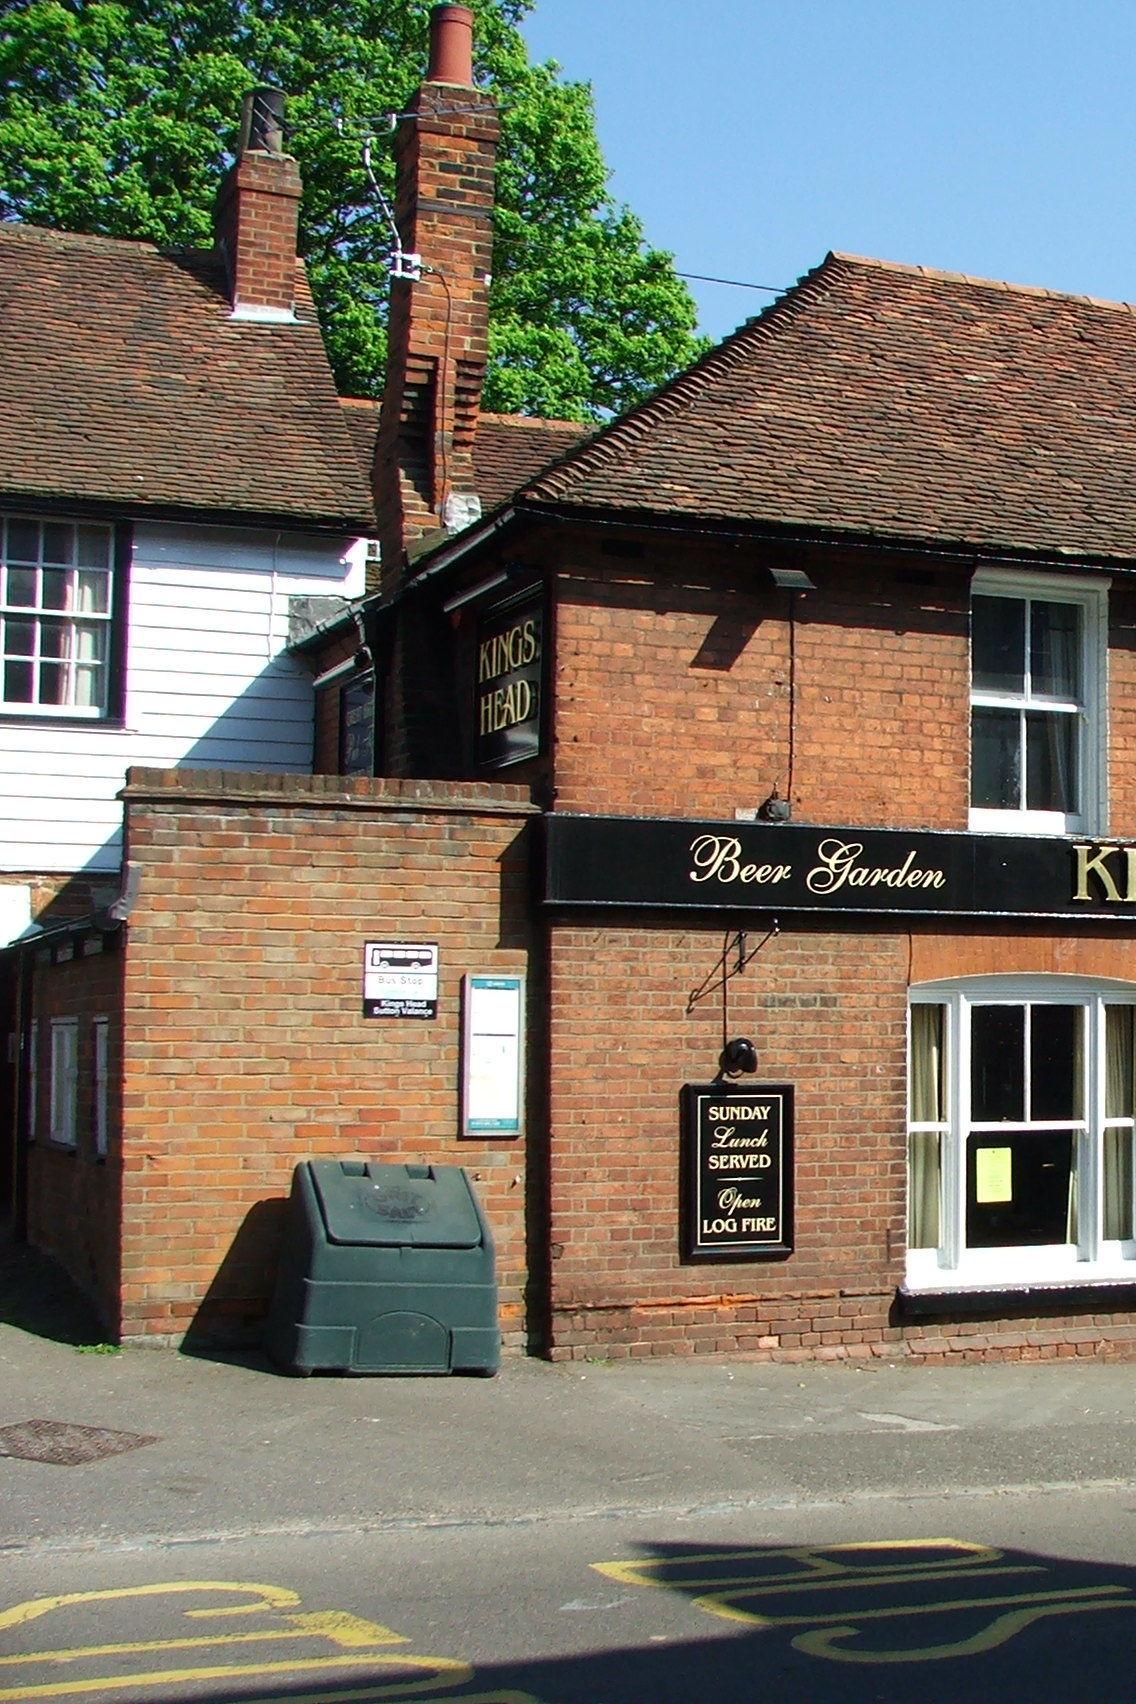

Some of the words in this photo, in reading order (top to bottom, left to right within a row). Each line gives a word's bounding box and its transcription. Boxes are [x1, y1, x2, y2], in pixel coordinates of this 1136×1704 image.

[479, 620, 536, 683] KINGS
[480, 680, 532, 736] HEAD
[690, 834, 792, 883] Beer
[806, 838, 947, 895] Garden
[378, 976, 396, 985] Bus
[400, 976, 423, 985] Stop
[708, 1106, 771, 1121] SUNDAY
[711, 1126, 769, 1148] Lunch
[708, 1154, 772, 1170] SERVED
[717, 1187, 762, 1216] Open
[703, 1219, 737, 1234] LOG
[742, 1217, 777, 1232] FIRE
